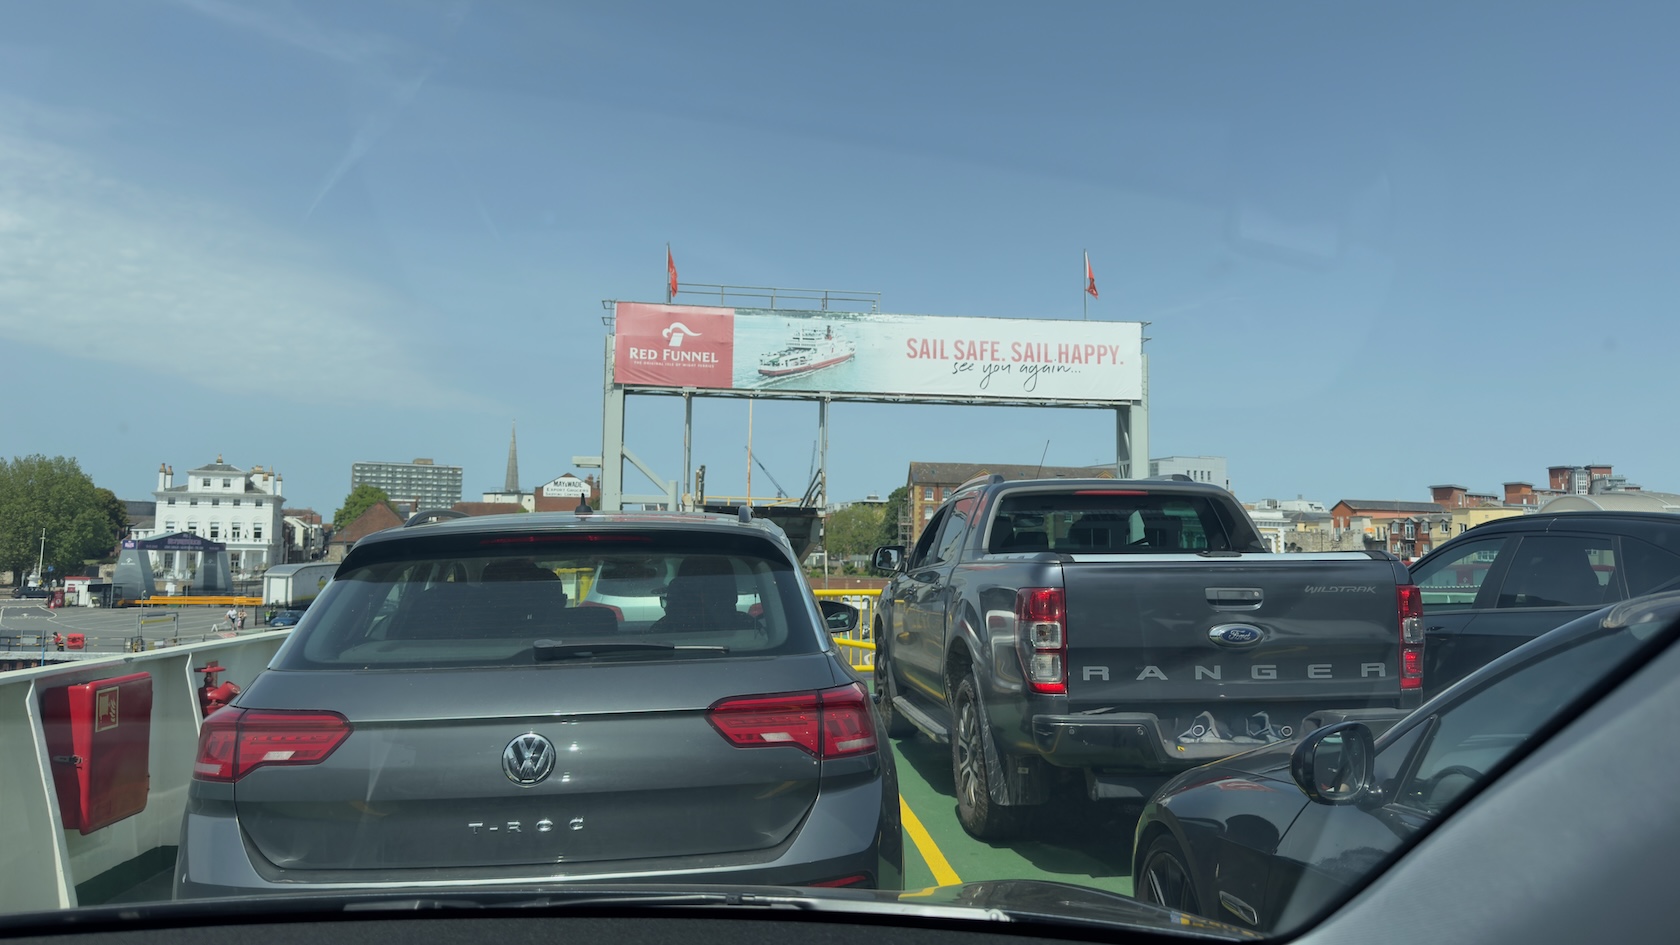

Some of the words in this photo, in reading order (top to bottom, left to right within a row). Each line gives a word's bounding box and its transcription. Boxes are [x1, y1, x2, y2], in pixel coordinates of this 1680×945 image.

[629, 347, 658, 360] RED
[663, 349, 719, 363] FUNNEL
[906, 338, 949, 360] SAIL
[953, 340, 1005, 362] SAFE.
[1010, 341, 1052, 363] SAIL
[1058, 343, 1124, 365] HAPPY.
[952, 361, 974, 375] see
[979, 363, 1011, 390] you
[1304, 585, 1377, 594] WILDTRAK
[1228, 629, 1252, 642] Ford
[1082, 662, 1386, 681] RANGER
[468, 817, 584, 834] T-ROC
